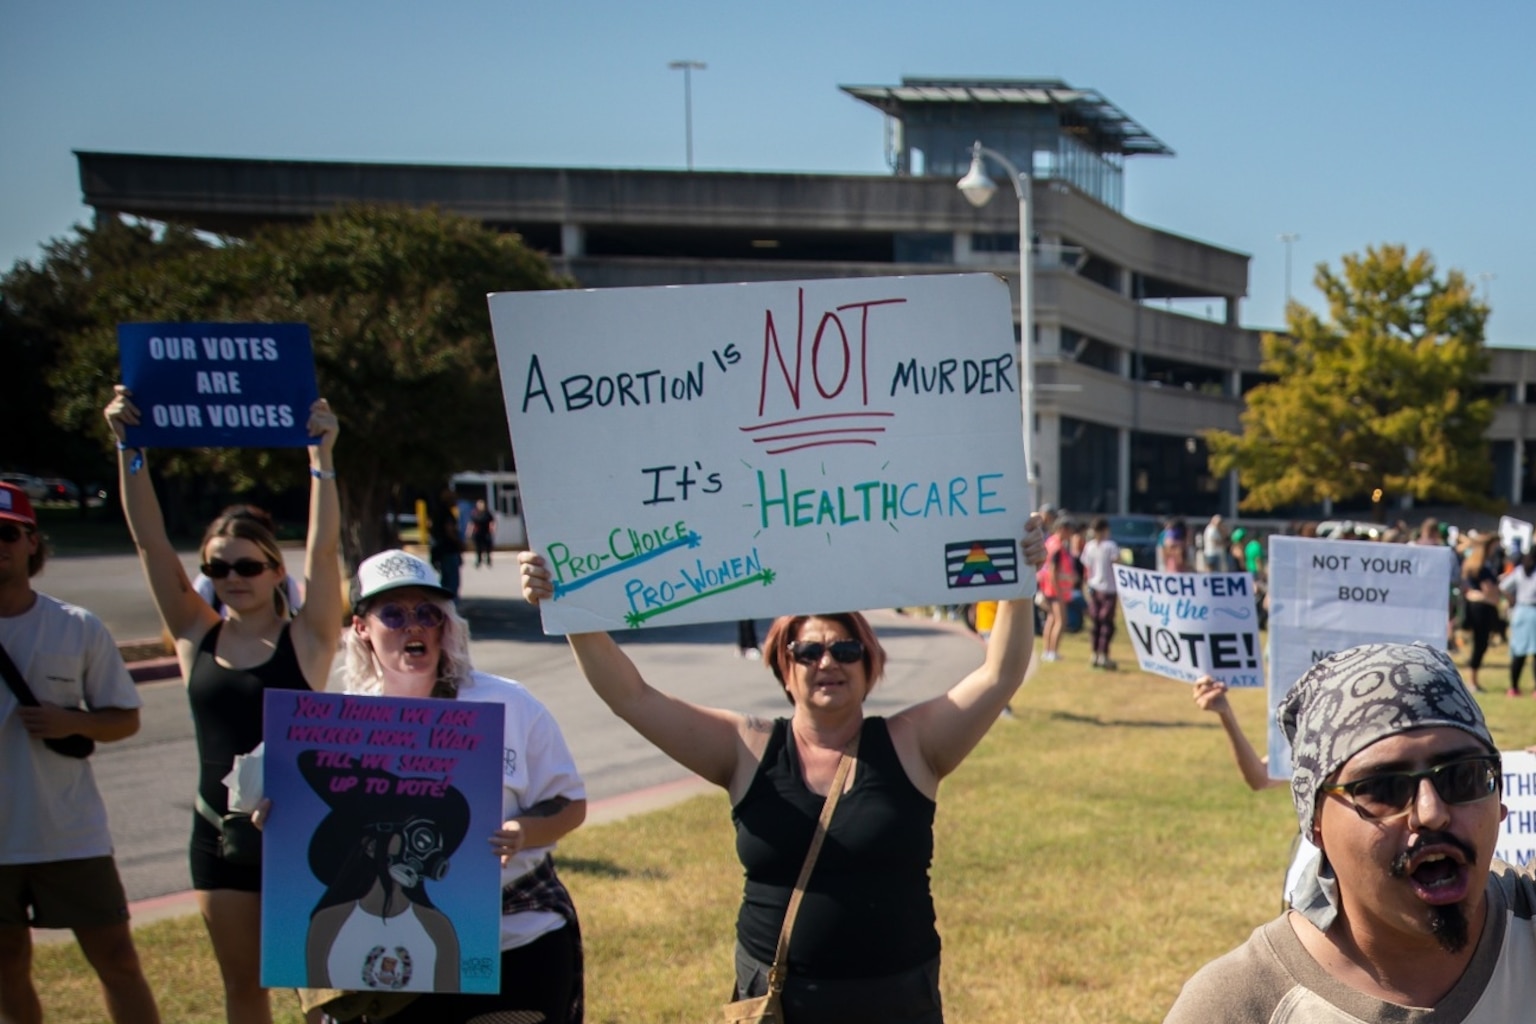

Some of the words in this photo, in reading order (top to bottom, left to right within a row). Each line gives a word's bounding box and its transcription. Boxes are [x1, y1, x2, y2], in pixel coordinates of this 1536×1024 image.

[149, 337, 197, 360] OUR
[201, 337, 278, 361] VOTES
[522, 353, 704, 414] ABORTION
[712, 343, 741, 372] IS
[758, 288, 907, 416] NOT
[890, 353, 1014, 397] MURDER
[196, 371, 242, 394] ARE
[152, 404, 202, 427] OUR
[206, 404, 294, 428] VOICES
[756, 468, 1007, 528] HEALTHCARE
[547, 521, 689, 583] PRO-CHOICE
[1312, 555, 1351, 570] NOT
[1360, 557, 1412, 574] YOUR
[625, 547, 762, 613] PRO-WOMEN
[1118, 569, 1196, 597] SNATCH
[1203, 576, 1247, 597] 'EM
[1338, 586, 1389, 603] BODY
[1148, 595, 1171, 626] by
[1176, 598, 1209, 620] the
[1130, 620, 1258, 669] VOTE!
[1230, 675, 1258, 686] ATX
[294, 696, 334, 719] YOU
[339, 698, 397, 722] THINK
[401, 707, 435, 724] WE
[437, 708, 479, 727] ARE
[287, 725, 363, 744] WICKED
[429, 728, 485, 750] WAIT
[316, 751, 353, 770] TILL
[361, 753, 394, 770] WE
[398, 754, 459, 772] SHOW
[329, 776, 358, 793] UP
[365, 778, 390, 794] TO
[396, 776, 453, 797] VOTE!
